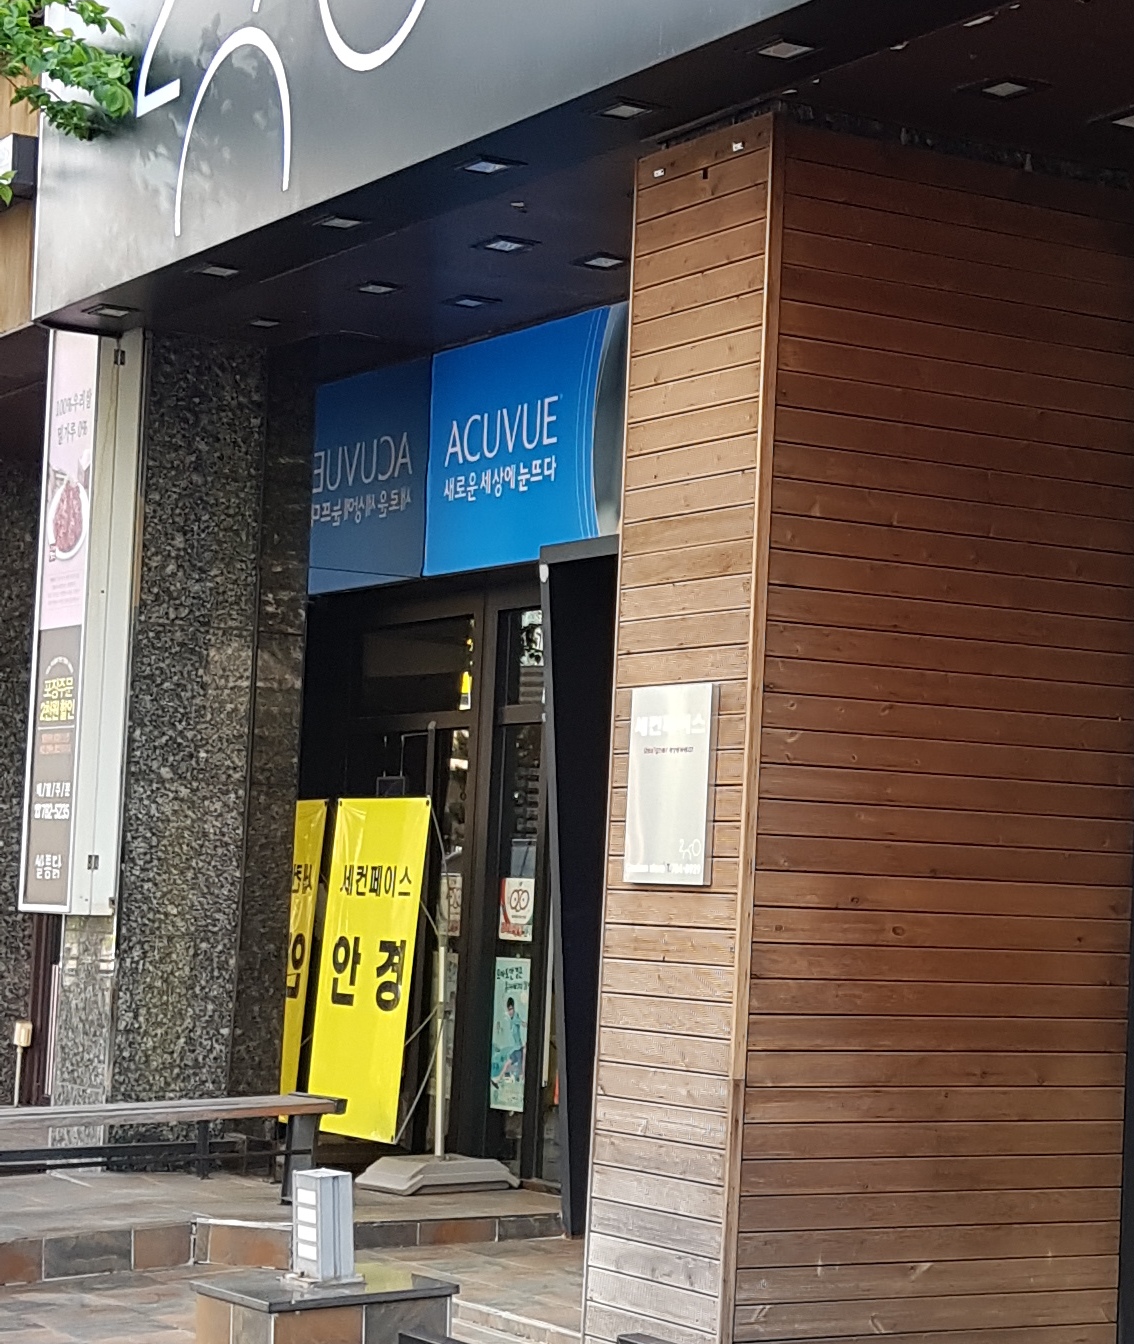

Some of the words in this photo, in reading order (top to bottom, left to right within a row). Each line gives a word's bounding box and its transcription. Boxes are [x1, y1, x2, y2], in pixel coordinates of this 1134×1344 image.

[444, 395, 559, 467] ACUVUE
[443, 471, 477, 502] 새로운
[480, 461, 516, 497] 세상에
[517, 455, 557, 492] 눈뜨다
[340, 864, 412, 897] 세컨페이스
